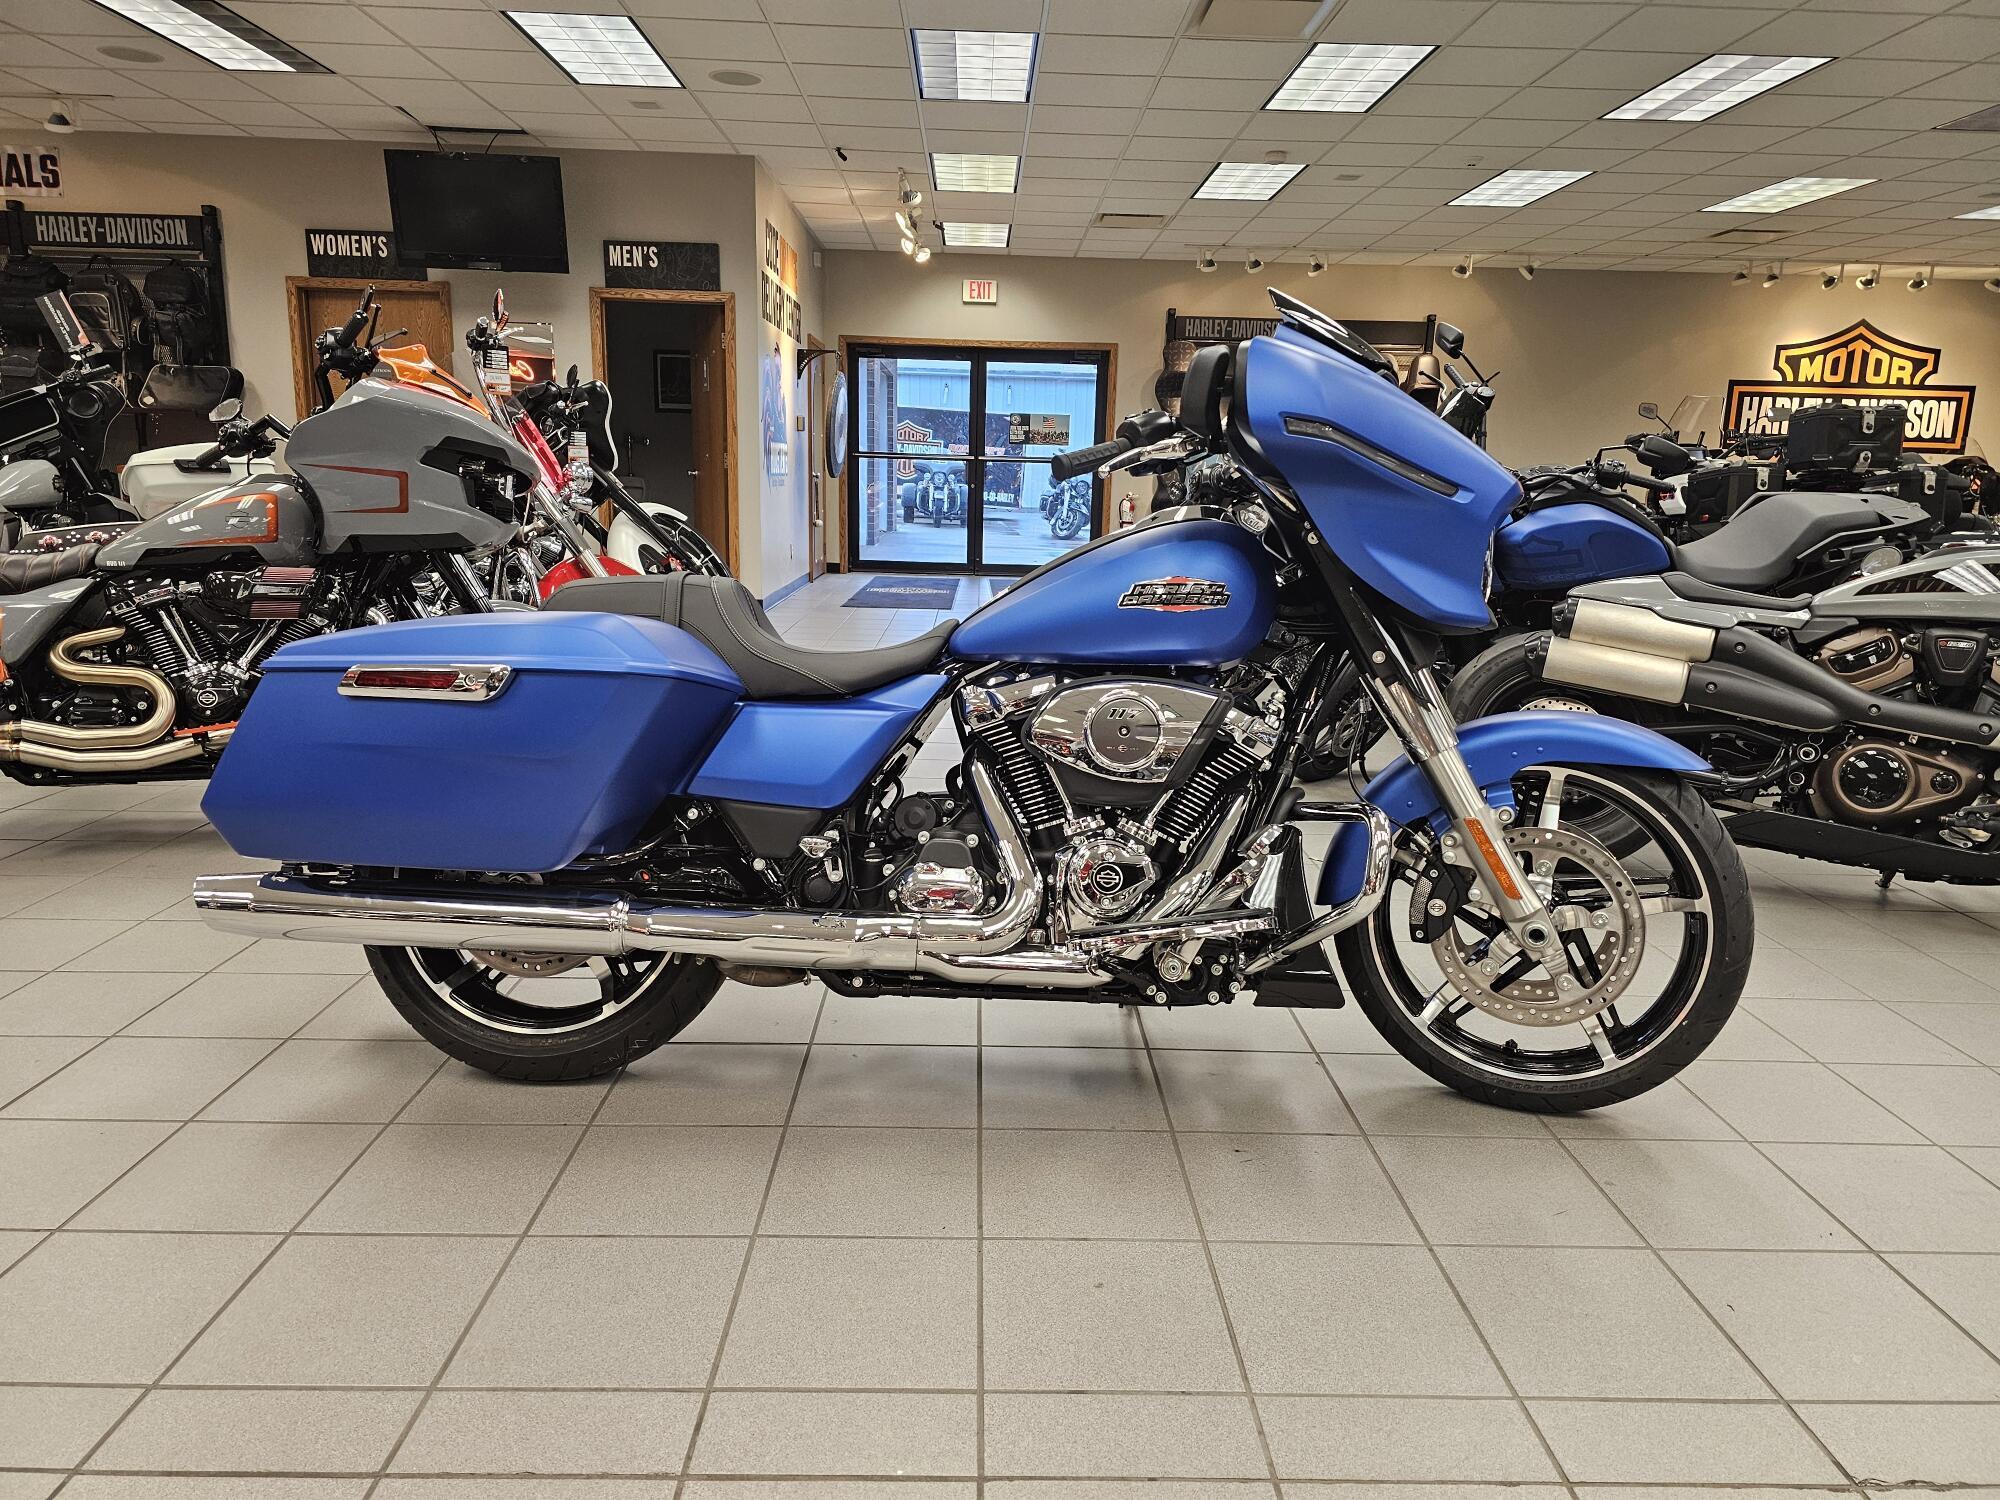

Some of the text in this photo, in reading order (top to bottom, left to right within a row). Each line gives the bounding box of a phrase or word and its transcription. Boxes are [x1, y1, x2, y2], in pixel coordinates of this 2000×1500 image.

[0, 153, 60, 188] ALS
[35, 215, 189, 246] HARLEY-DAVIDSON
[310, 233, 388, 257] WOMEN'S
[608, 245, 659, 268] MEN'S
[969, 281, 992, 300] EXIT
[1798, 339, 1914, 386] MOTOR
[897, 427, 924, 442] OTOR
[1123, 595, 1228, 606] DAVIDSON
[1107, 707, 1144, 720] 117
